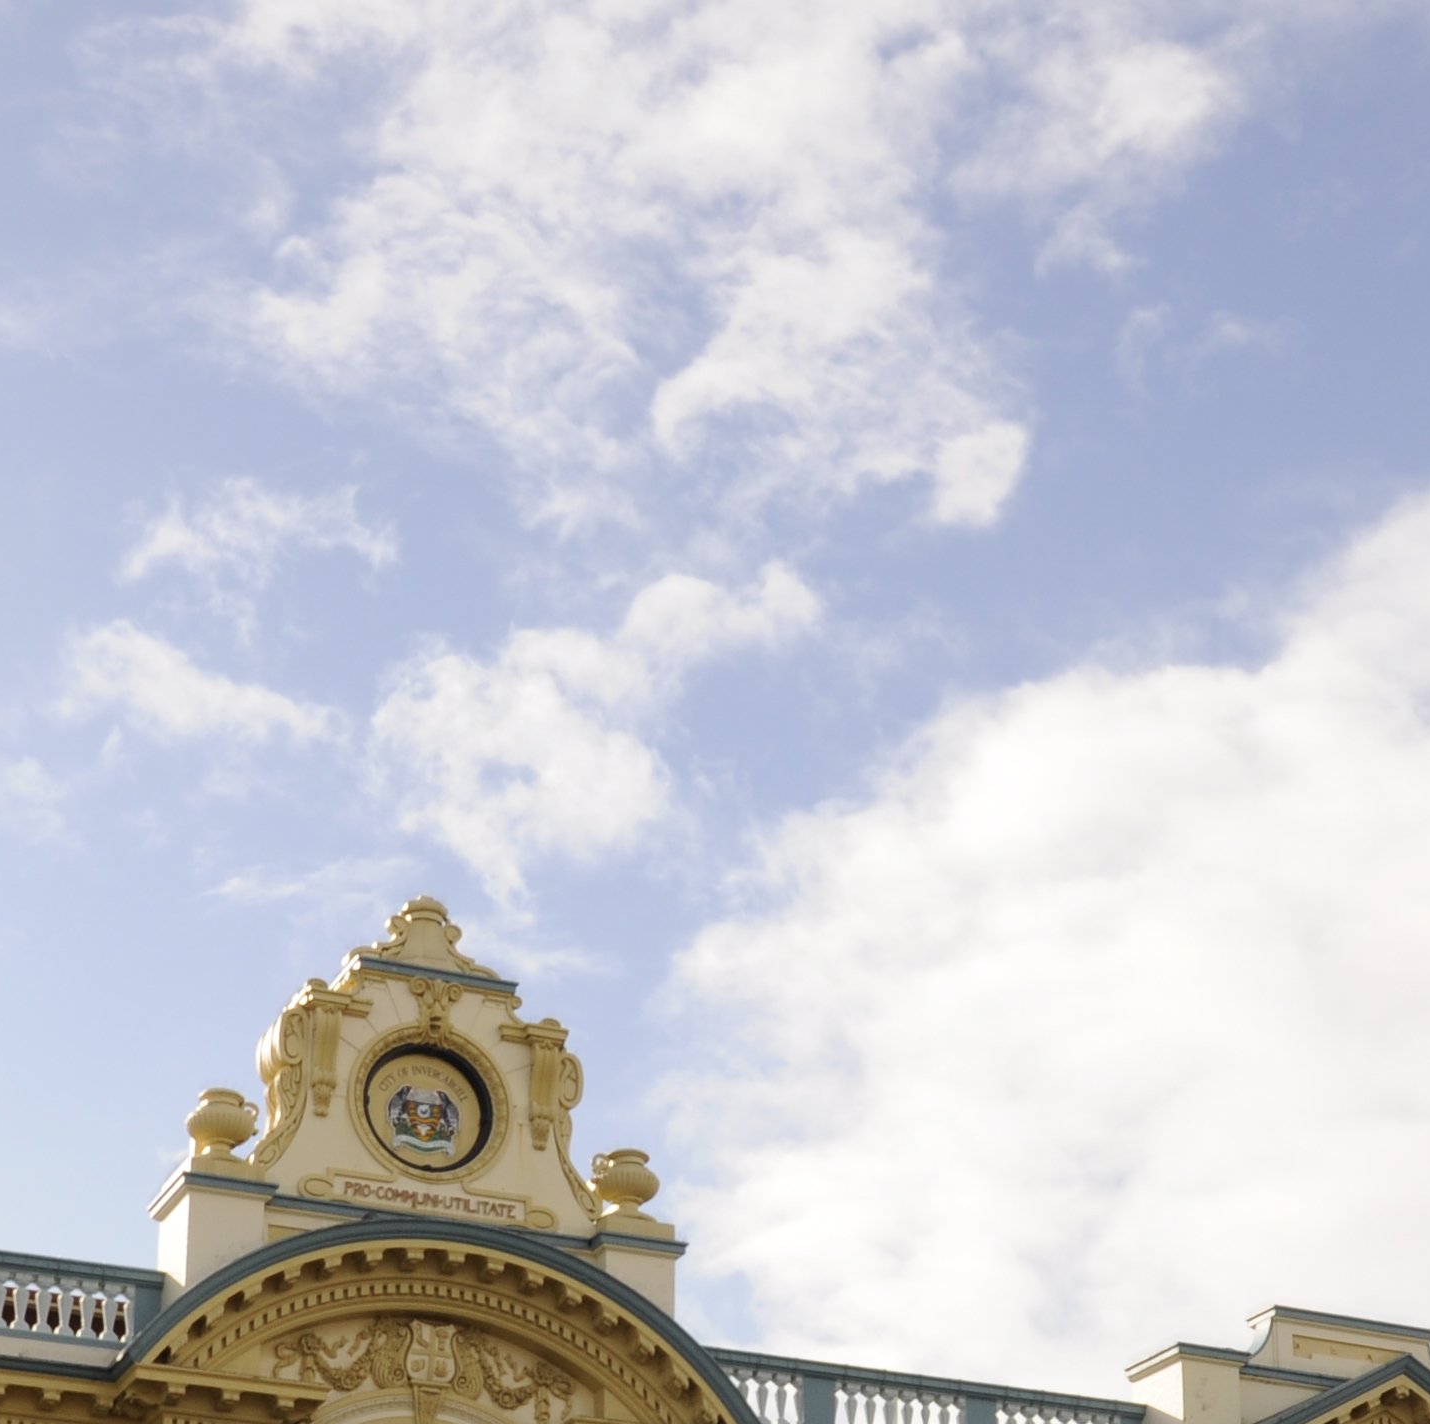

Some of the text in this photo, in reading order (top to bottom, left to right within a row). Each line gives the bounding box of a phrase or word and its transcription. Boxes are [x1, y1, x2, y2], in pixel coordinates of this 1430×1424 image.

[378, 1065, 468, 1103] CITY OF INVERCARGILL
